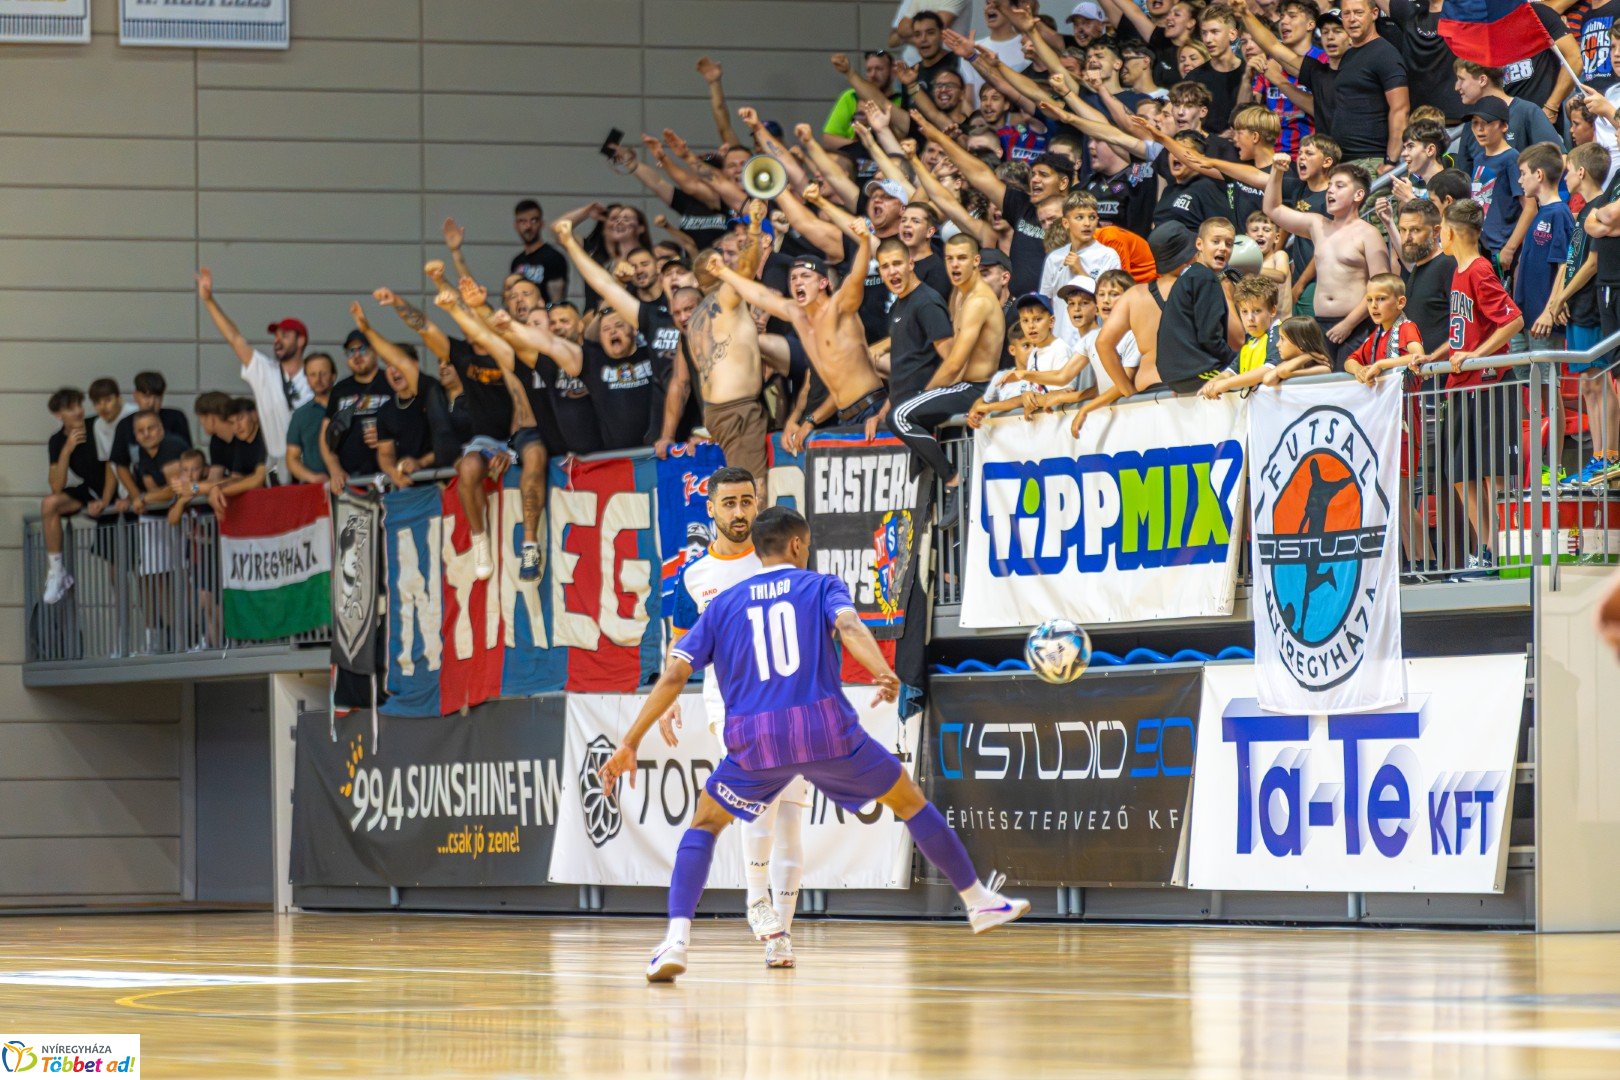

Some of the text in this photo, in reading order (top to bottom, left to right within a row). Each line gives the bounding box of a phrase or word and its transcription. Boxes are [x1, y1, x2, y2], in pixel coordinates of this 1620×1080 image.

[815, 453, 920, 514] EASTERN
[1268, 418, 1374, 491] FUTSAL
[702, 588, 718, 598] JAKO
[750, 578, 791, 601] THIAGO
[747, 601, 800, 682] 10
[351, 767, 405, 832] 99.4
[407, 761, 518, 819] SUNSHINE
[1222, 708, 1496, 859] Ta-Te KFT
[472, 825, 484, 860] jó
[488, 826, 520, 853] zene!
[946, 806, 1179, 830] ÉPÍTÉSZTERVEZŐ KF
